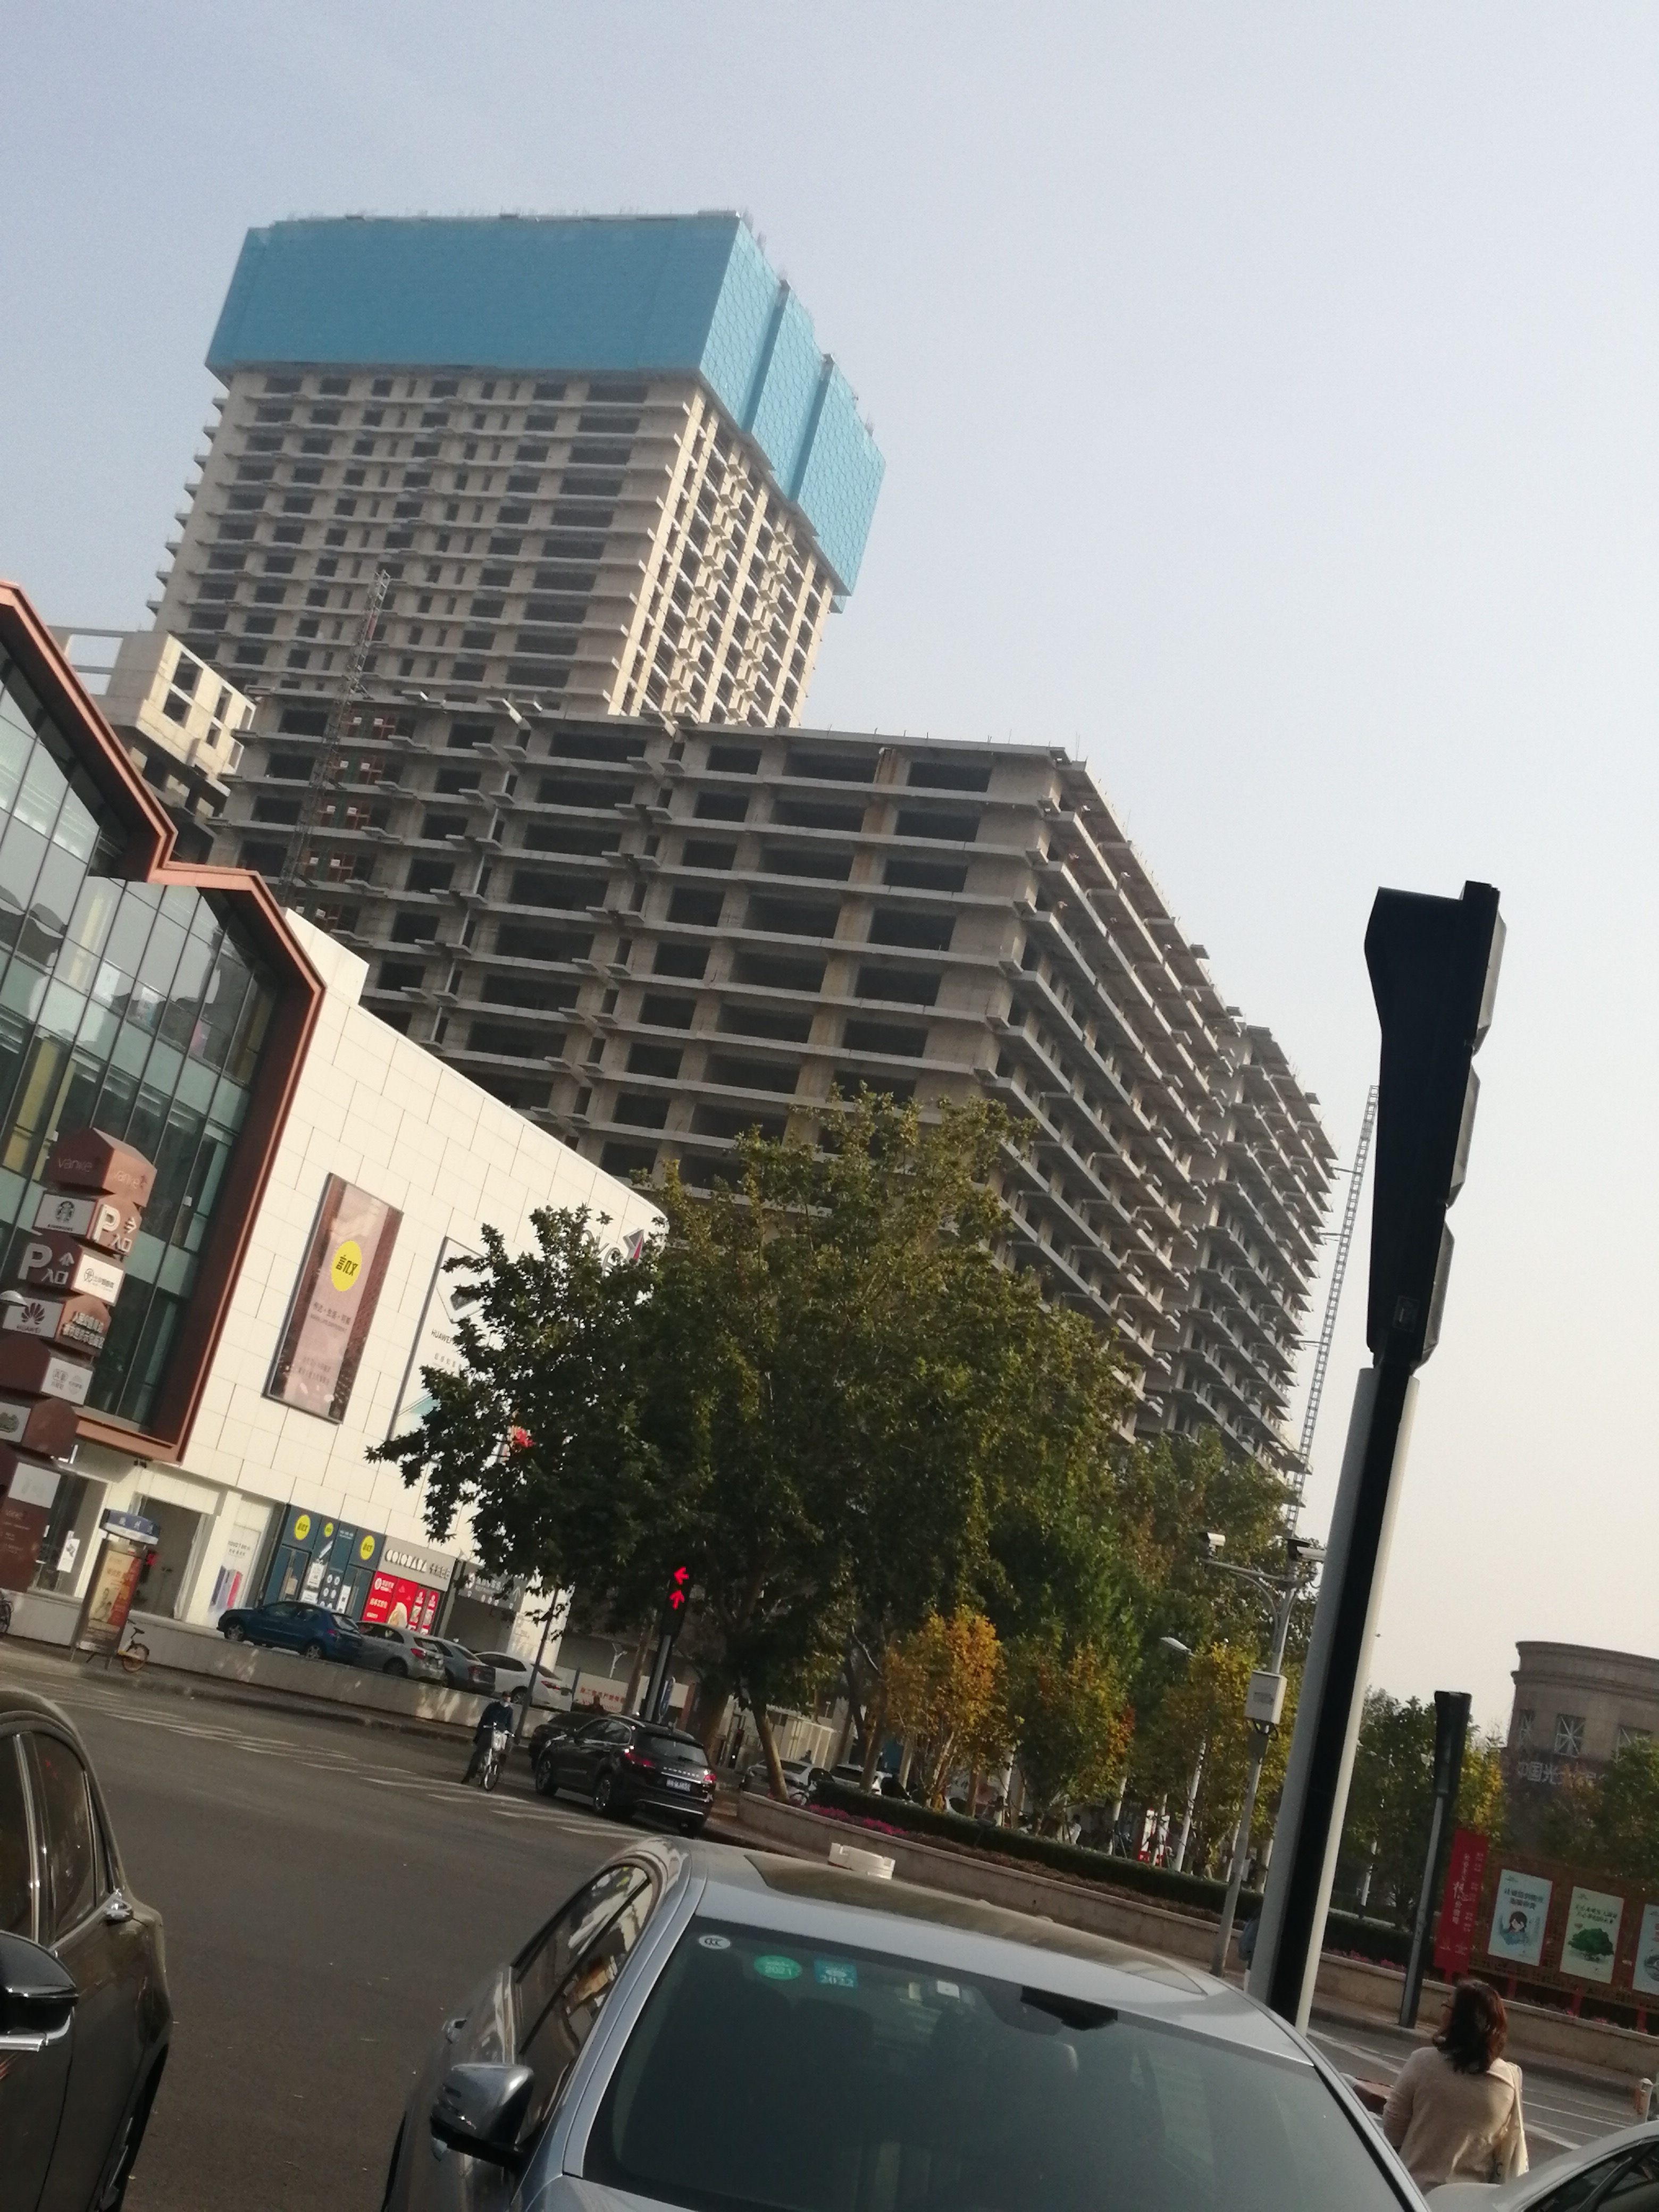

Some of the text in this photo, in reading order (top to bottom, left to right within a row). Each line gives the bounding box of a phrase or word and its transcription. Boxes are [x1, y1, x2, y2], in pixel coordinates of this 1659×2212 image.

[58, 1158, 93, 1172] vanke
[93, 1204, 121, 1244] P
[108, 1234, 132, 1253] 入口
[18, 1243, 53, 1280] P
[41, 1268, 69, 1285] 入口
